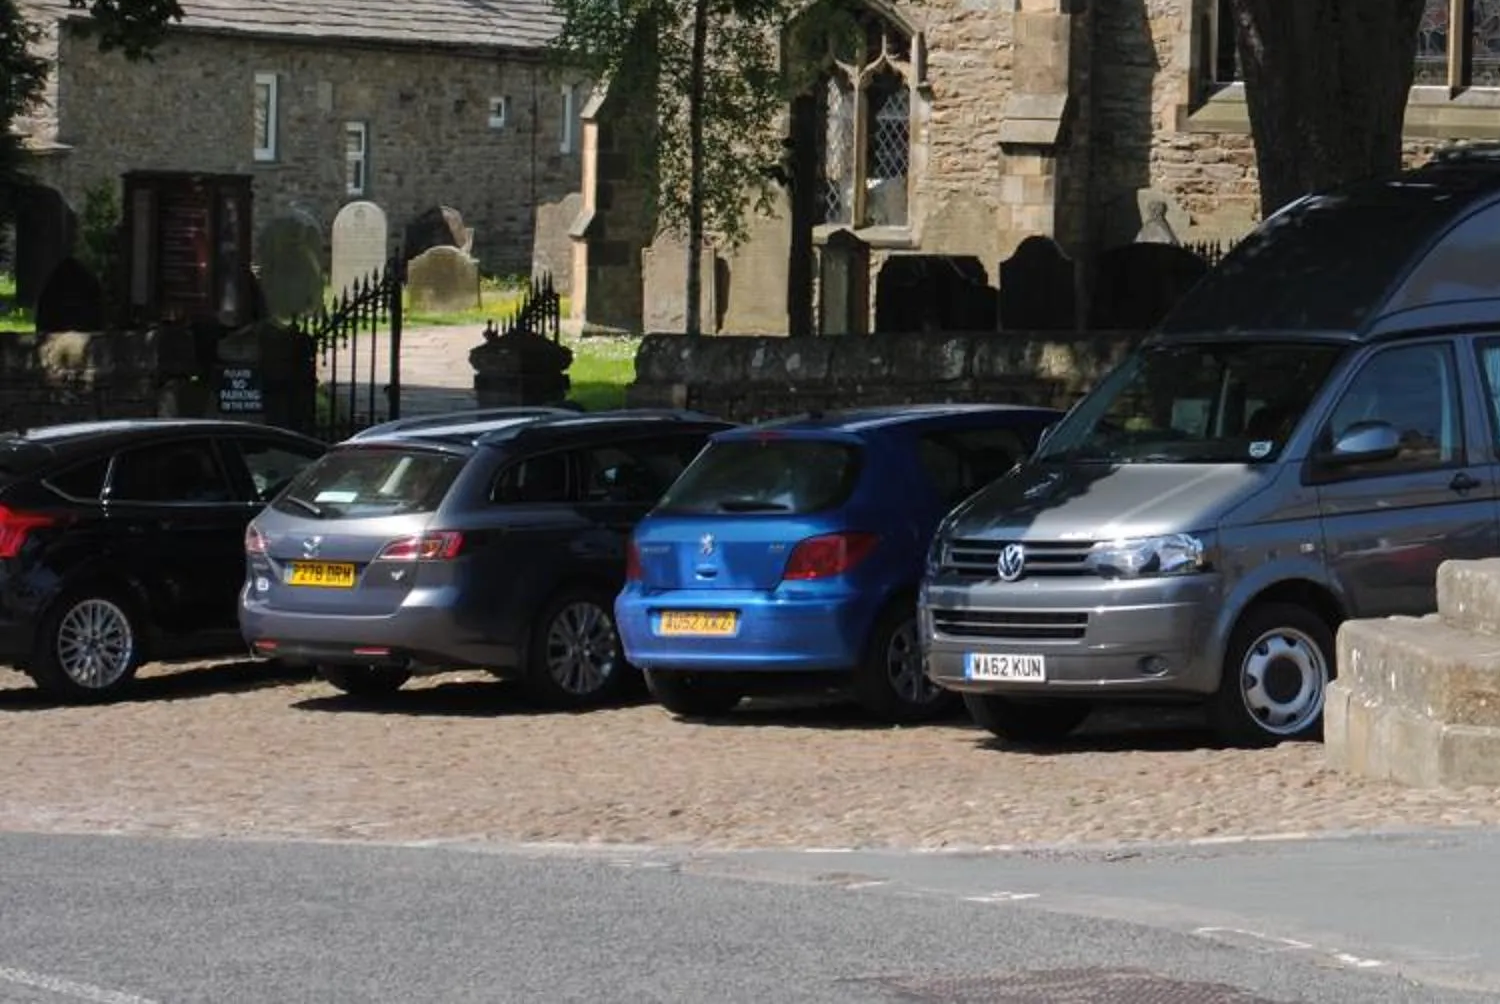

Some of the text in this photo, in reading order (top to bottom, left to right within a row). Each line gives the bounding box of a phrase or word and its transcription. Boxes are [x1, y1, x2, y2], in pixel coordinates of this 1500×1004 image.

[220, 389, 261, 401] PARKING
[973, 656, 1041, 678] WA62 KUN
